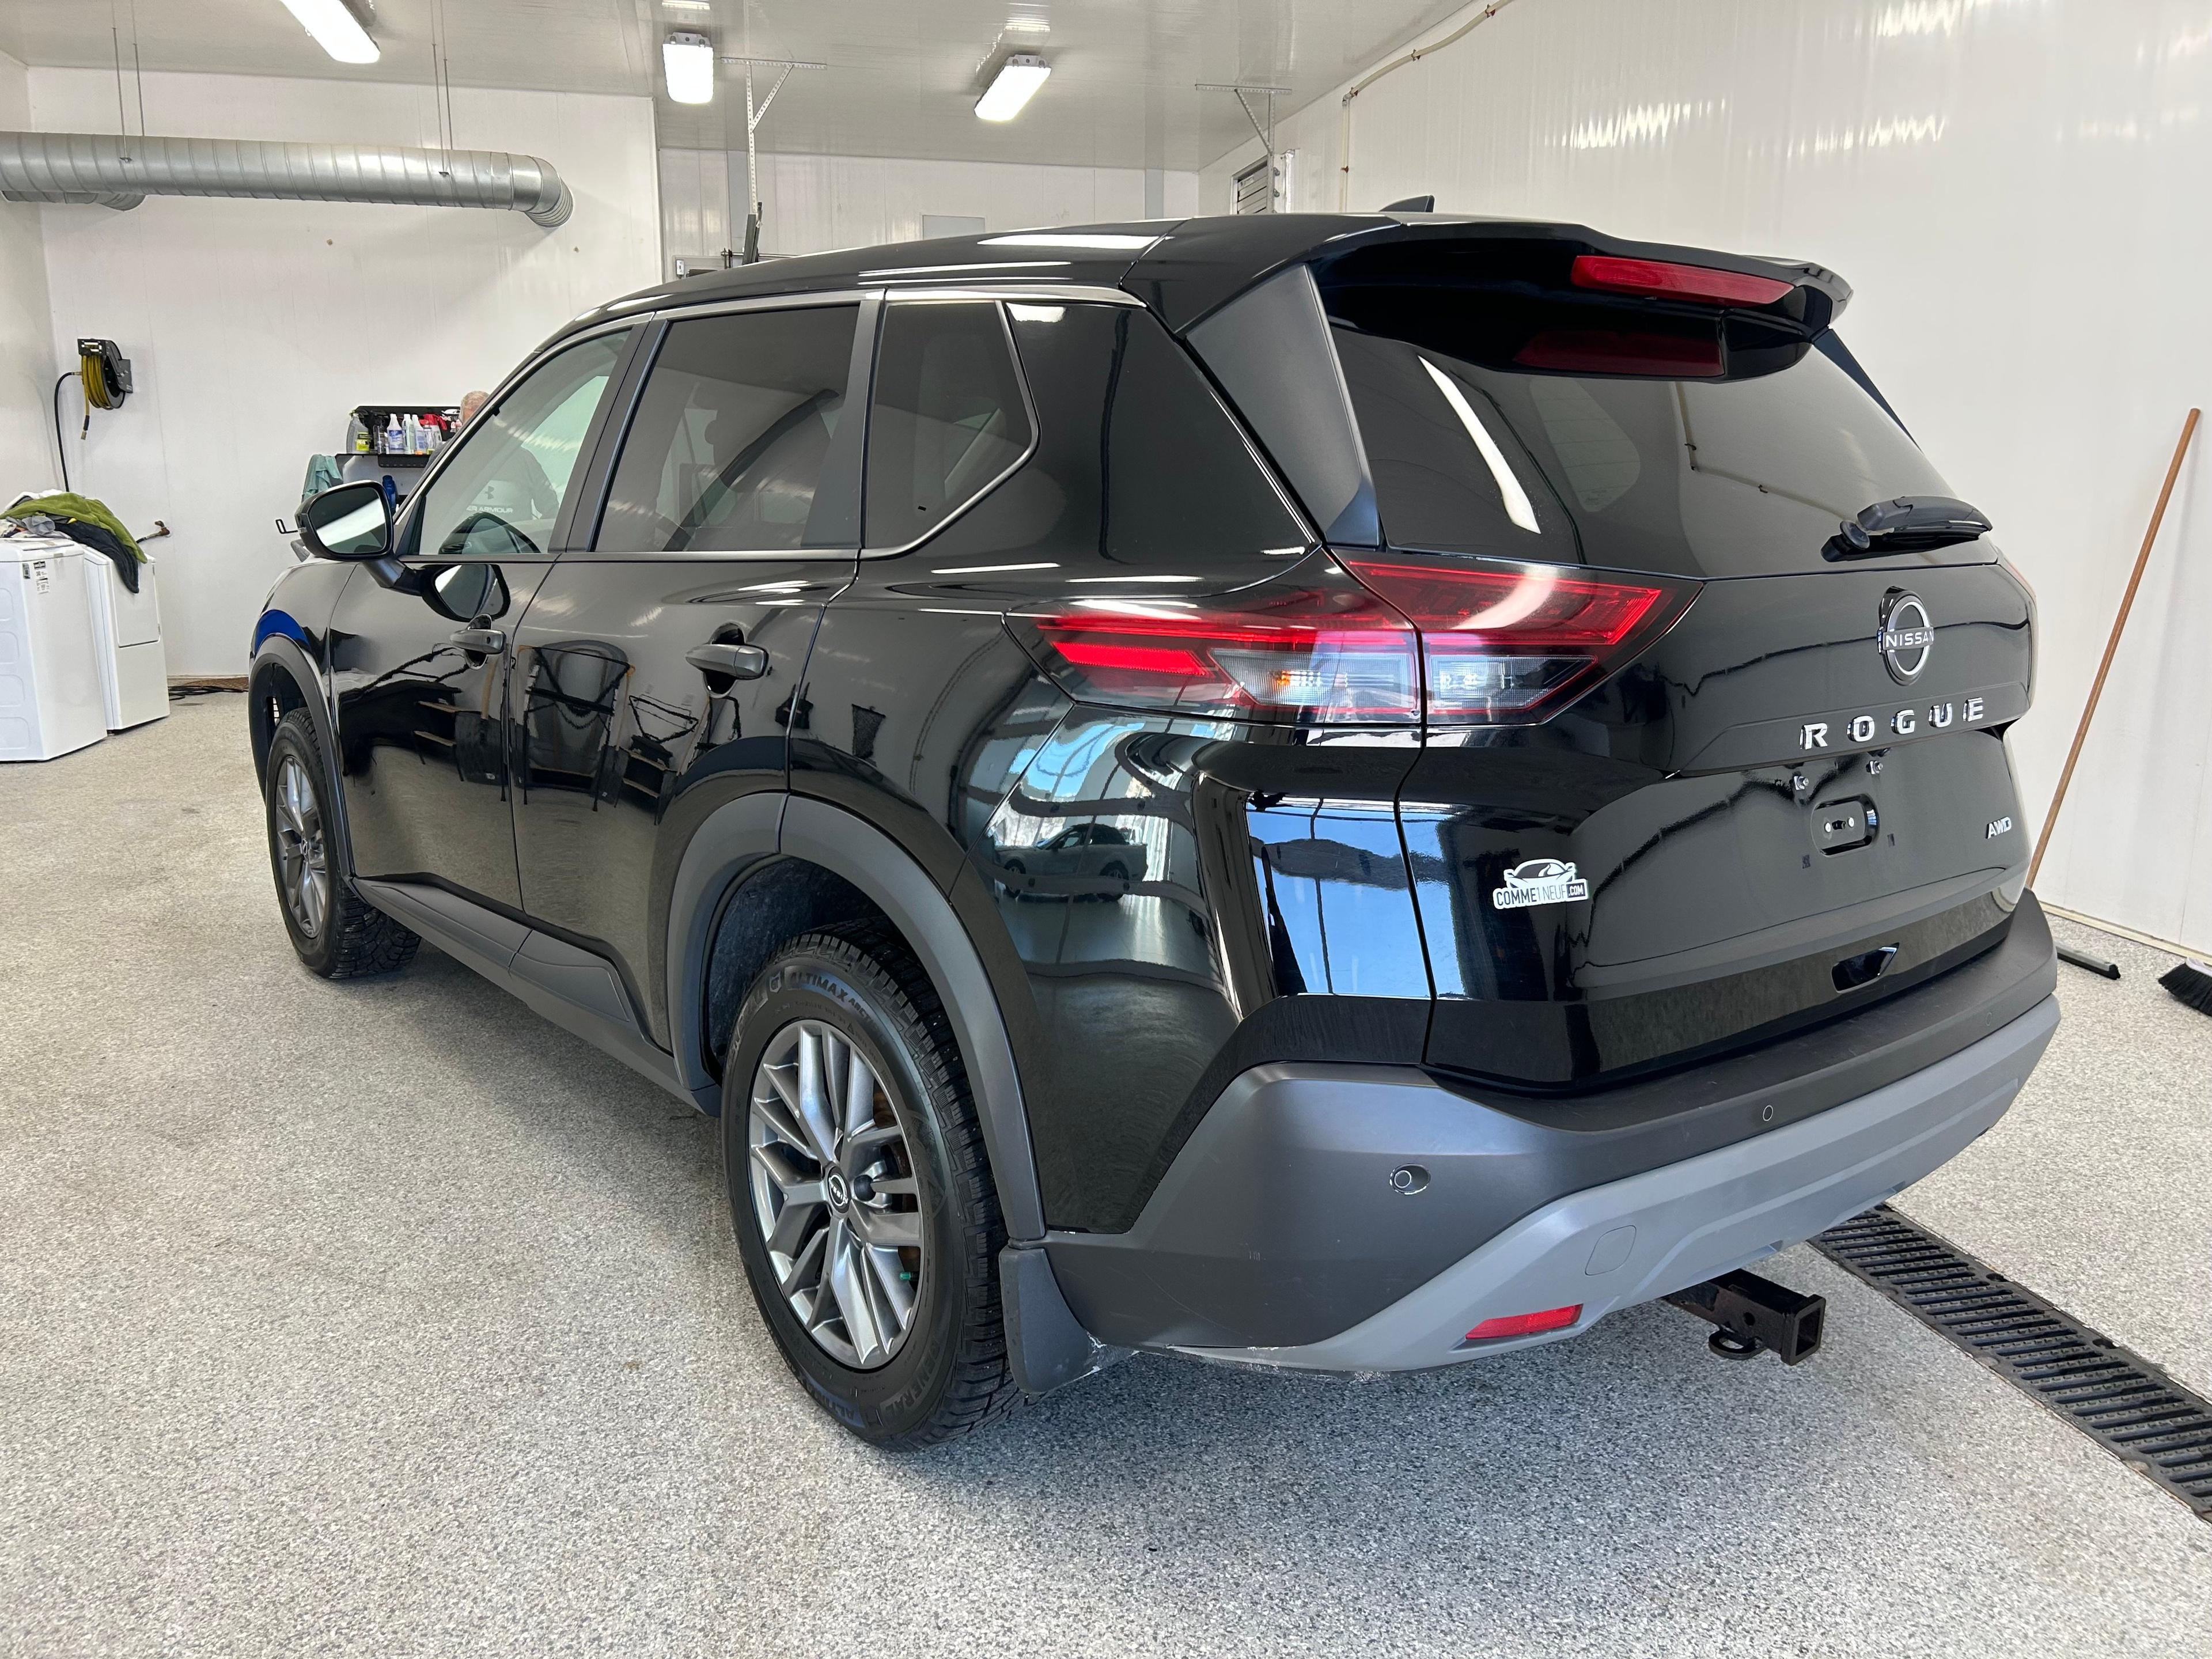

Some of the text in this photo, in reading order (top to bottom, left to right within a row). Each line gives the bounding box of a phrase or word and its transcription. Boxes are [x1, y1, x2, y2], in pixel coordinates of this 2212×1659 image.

[1885, 627, 1934, 647] NISSAN
[1800, 696, 1984, 750] ROGUE
[1986, 817, 2012, 839] AWD
[790, 971, 849, 1002] ALTIMAX
